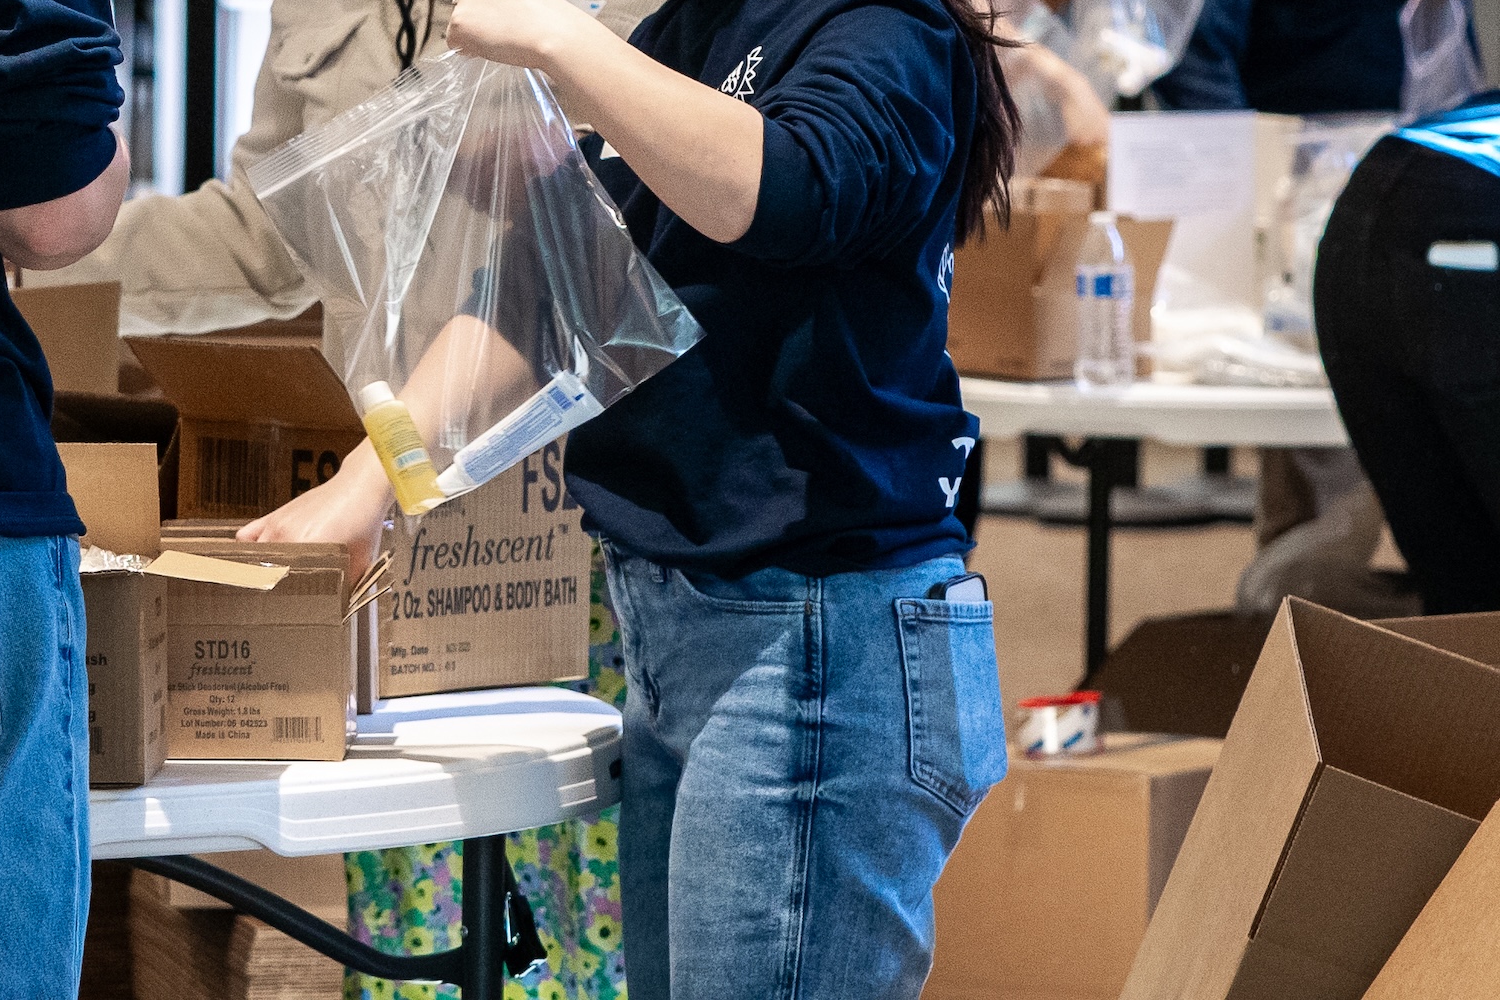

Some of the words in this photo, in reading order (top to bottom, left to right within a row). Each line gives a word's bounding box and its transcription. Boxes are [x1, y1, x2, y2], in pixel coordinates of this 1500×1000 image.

[392, 592, 399, 620] 2
[403, 591, 424, 619] Oz.
[427, 584, 491, 618] SHAMPOO
[494, 583, 504, 612] &
[506, 580, 541, 610] BODY
[544, 575, 578, 606] BATH
[194, 640, 251, 660] STD16
[183, 706, 206, 715] Gross
[181, 719, 194, 728] Lot
[195, 730, 216, 739] Made
[228, 730, 251, 739] China
